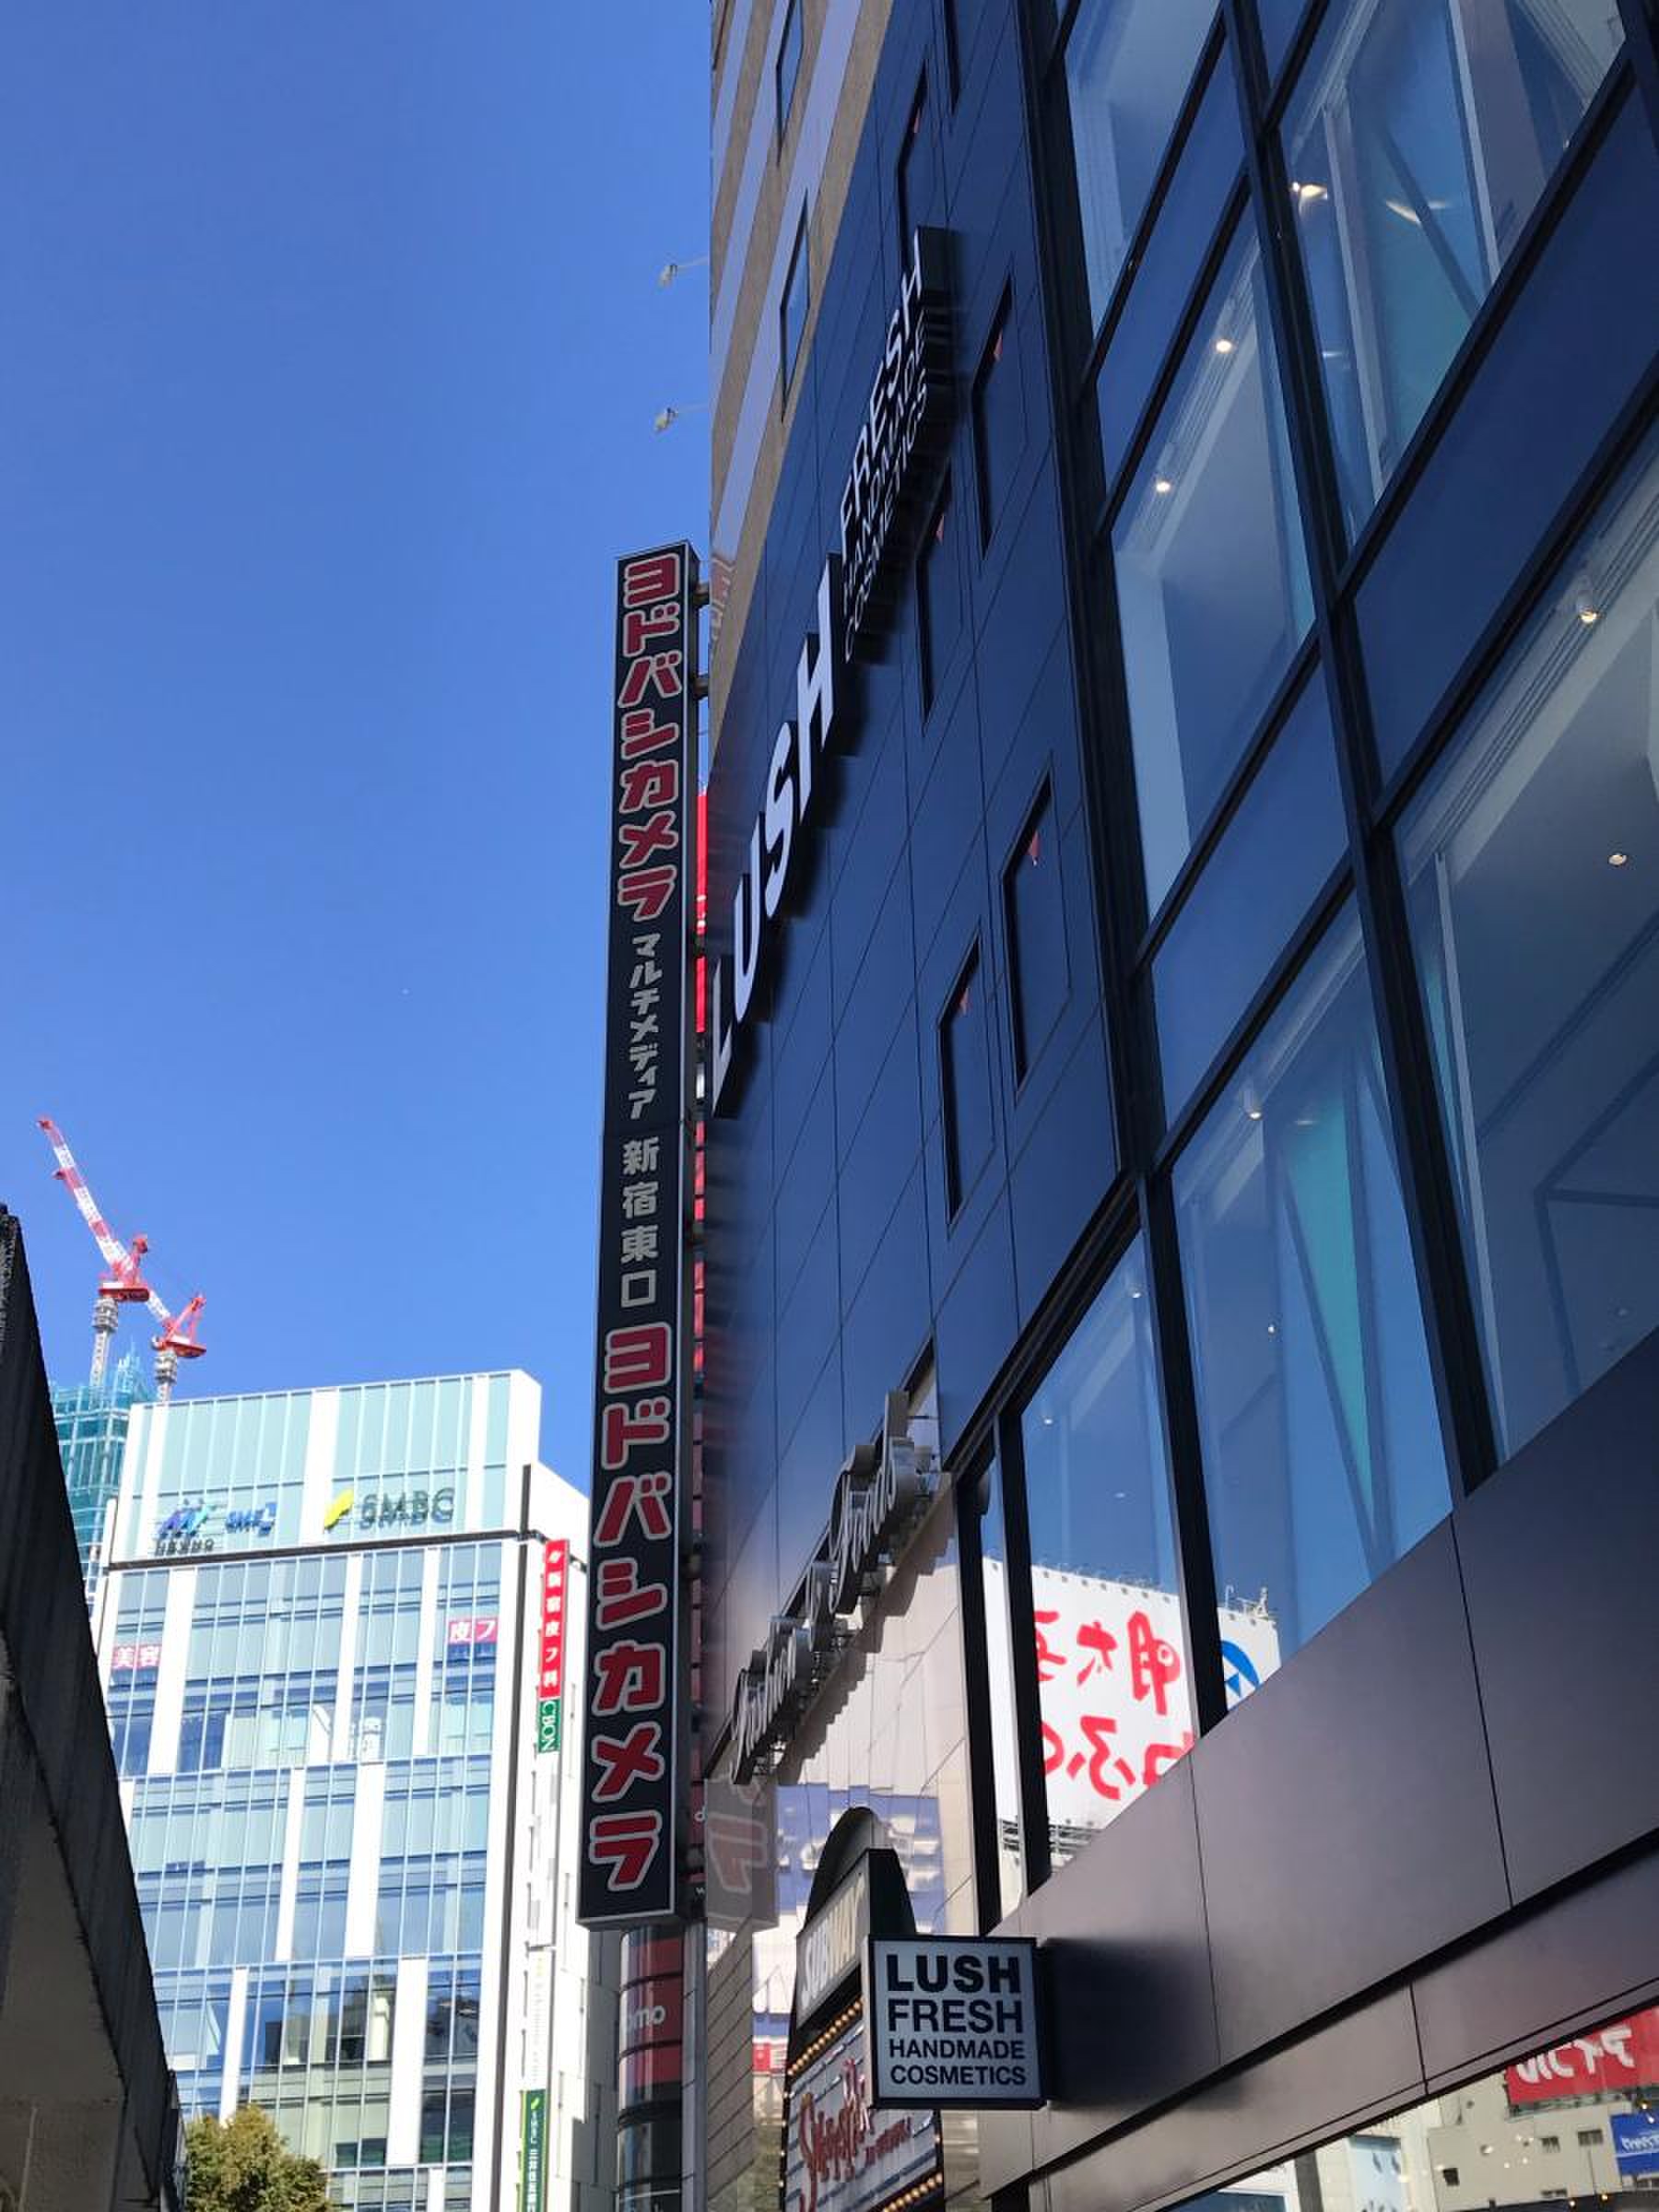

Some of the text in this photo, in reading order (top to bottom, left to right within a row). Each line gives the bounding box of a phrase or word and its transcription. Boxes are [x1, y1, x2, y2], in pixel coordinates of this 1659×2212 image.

[840, 228, 922, 559] FRESH
[617, 552, 682, 923] ヨドバシカメラ
[712, 555, 833, 1114] LUSH
[629, 933, 663, 1120] マルチメディア
[620, 1135, 660, 1308] 新宿東口
[360, 1487, 455, 1531] SMBC
[589, 1322, 673, 1892] ヨドバシカメラ
[887, 1954, 1021, 1994] LUSH
[888, 1998, 1024, 2033] FRESH
[889, 2039, 1026, 2060] HANDMADE
[890, 2065, 1027, 2086] COSMETICS
